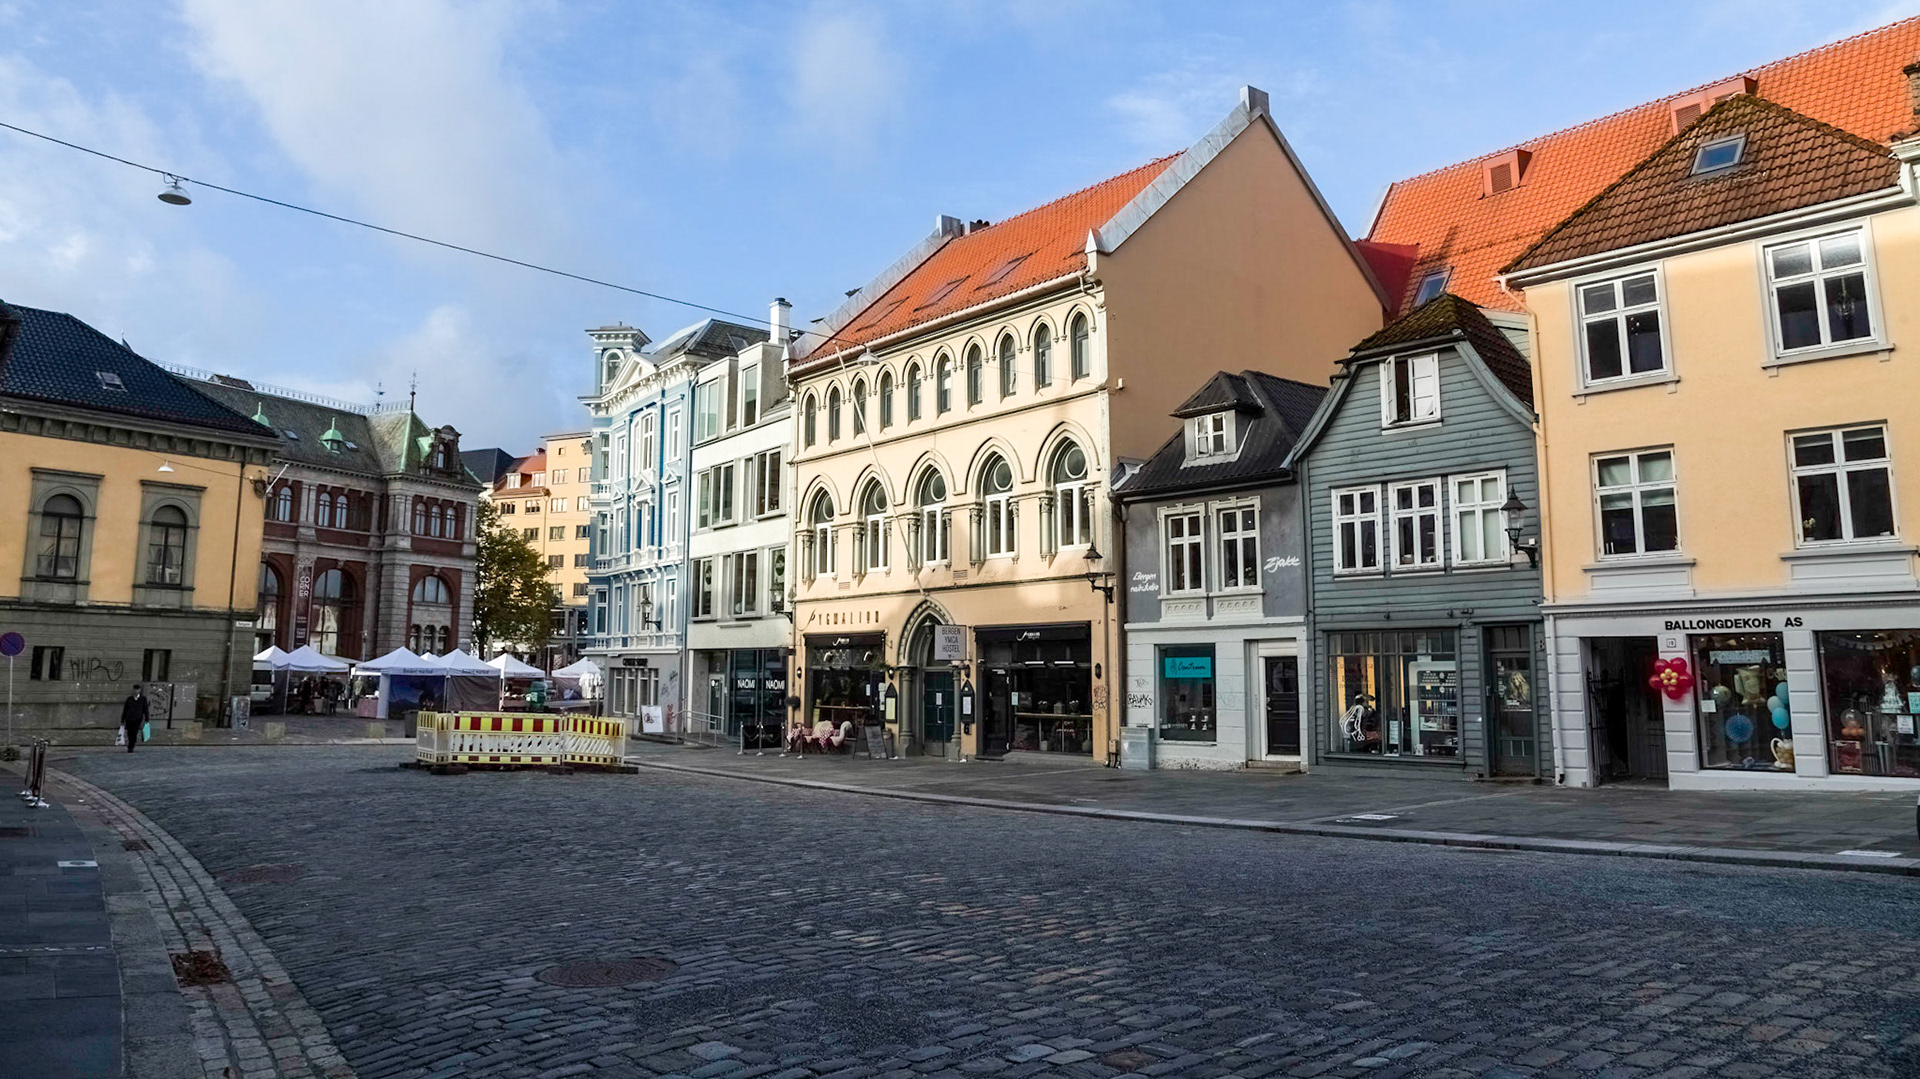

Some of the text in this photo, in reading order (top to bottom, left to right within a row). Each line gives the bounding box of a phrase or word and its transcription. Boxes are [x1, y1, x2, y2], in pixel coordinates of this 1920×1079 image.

[1132, 571, 1157, 584] Bergen
[1664, 616, 1804, 631] BALLONGDEKOR AS
[941, 626, 961, 635] BERGEN
[944, 635, 959, 644] YMCA
[941, 644, 960, 652] HOSTEL
[737, 679, 756, 689] NAOMI
[765, 679, 786, 690] NAOMI
